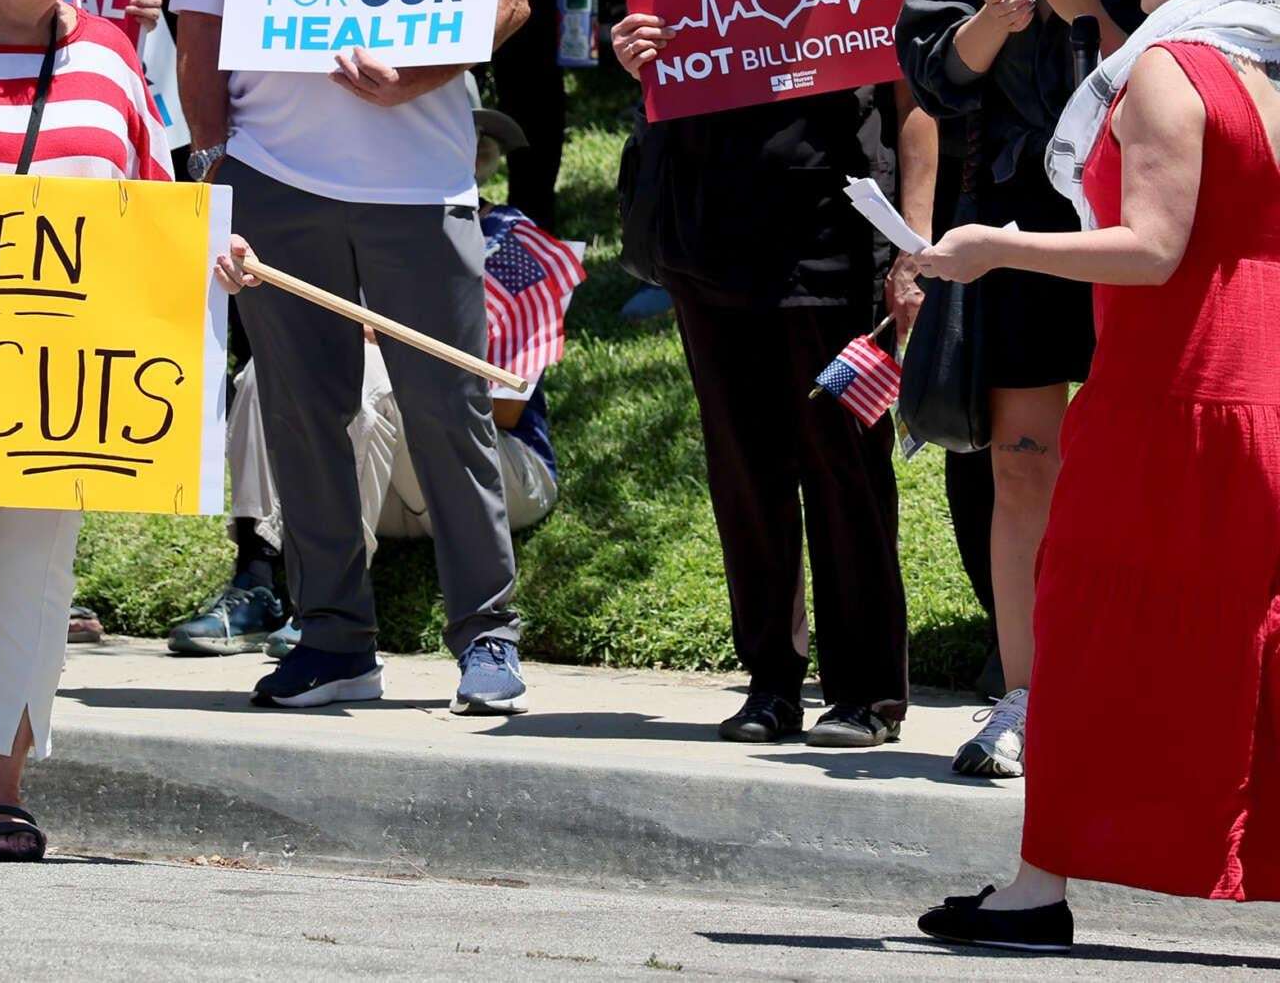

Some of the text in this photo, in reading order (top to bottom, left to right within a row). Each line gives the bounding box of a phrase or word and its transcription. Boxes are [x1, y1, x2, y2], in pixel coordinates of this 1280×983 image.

[261, 10, 464, 51] HEALTH
[655, 24, 896, 86] NOT BILLIONAIR
